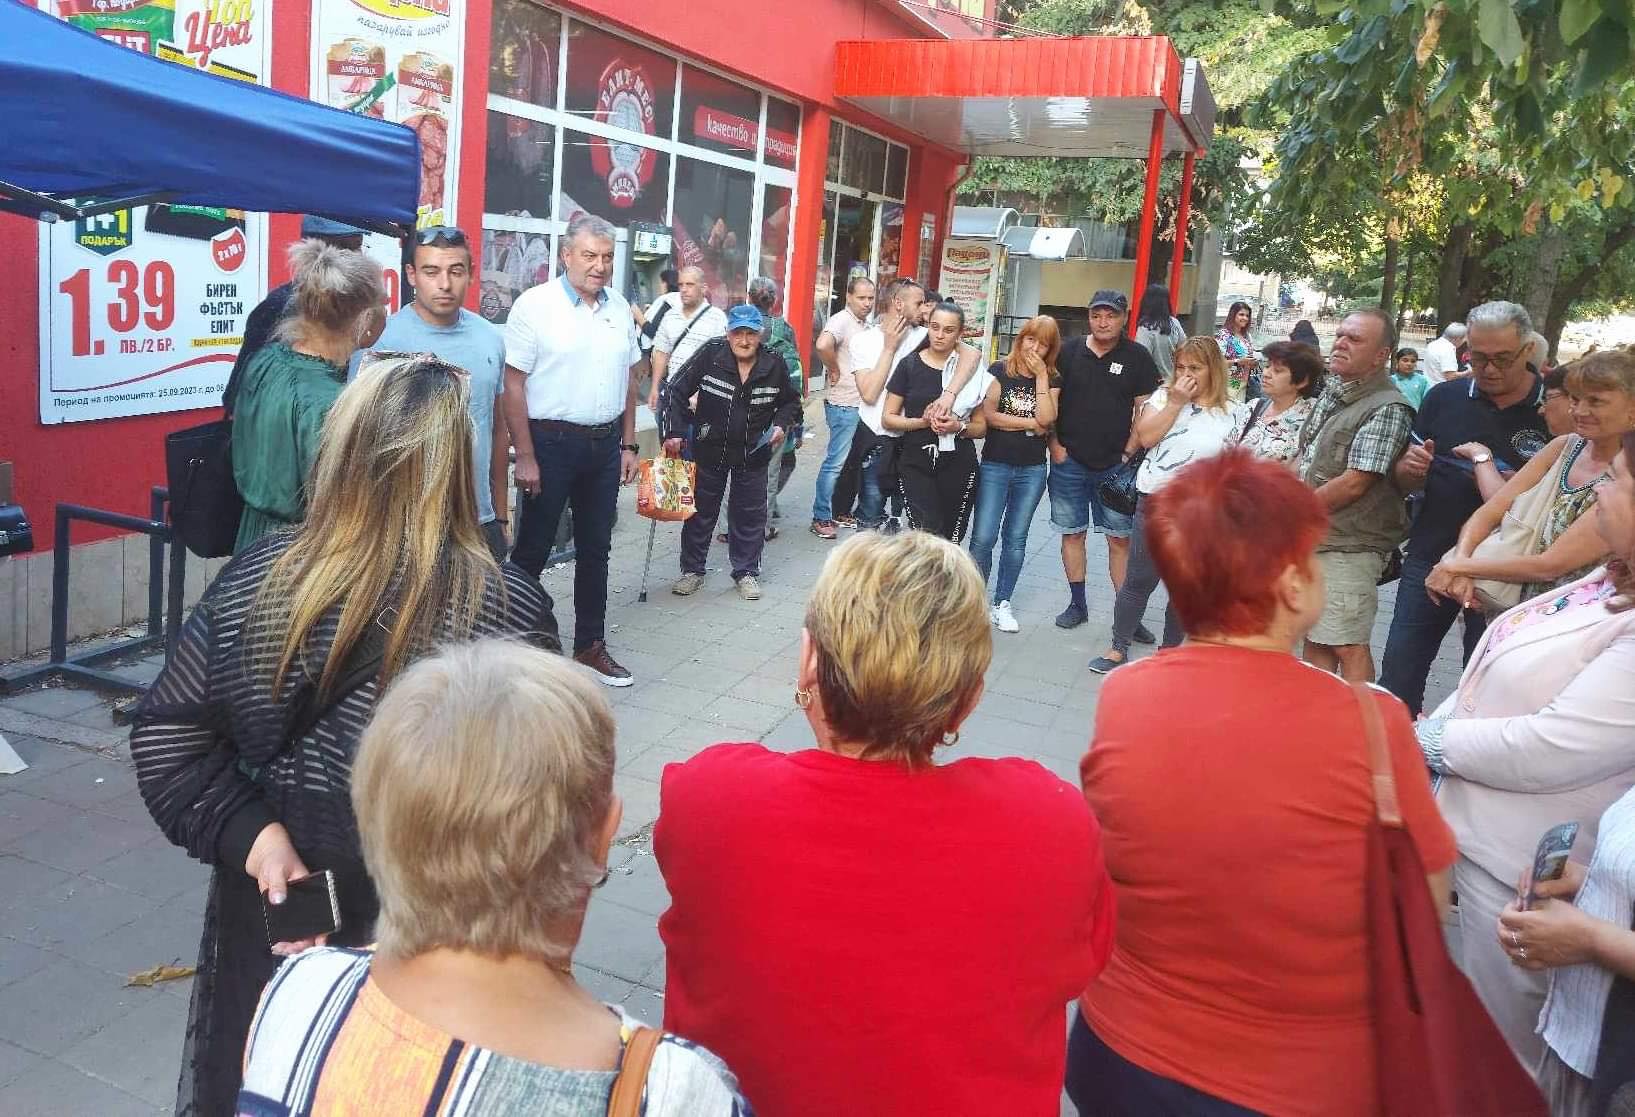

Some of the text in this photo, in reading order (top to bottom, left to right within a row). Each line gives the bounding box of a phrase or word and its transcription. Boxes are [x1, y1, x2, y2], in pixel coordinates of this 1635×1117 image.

[80, 234, 127, 248] ПОДАРЪК
[206, 283, 237, 298] БИРЕН
[199, 301, 243, 316] ФЪСТЪК
[210, 319, 235, 334] ЕЛИТ
[54, 398, 89, 409] Период
